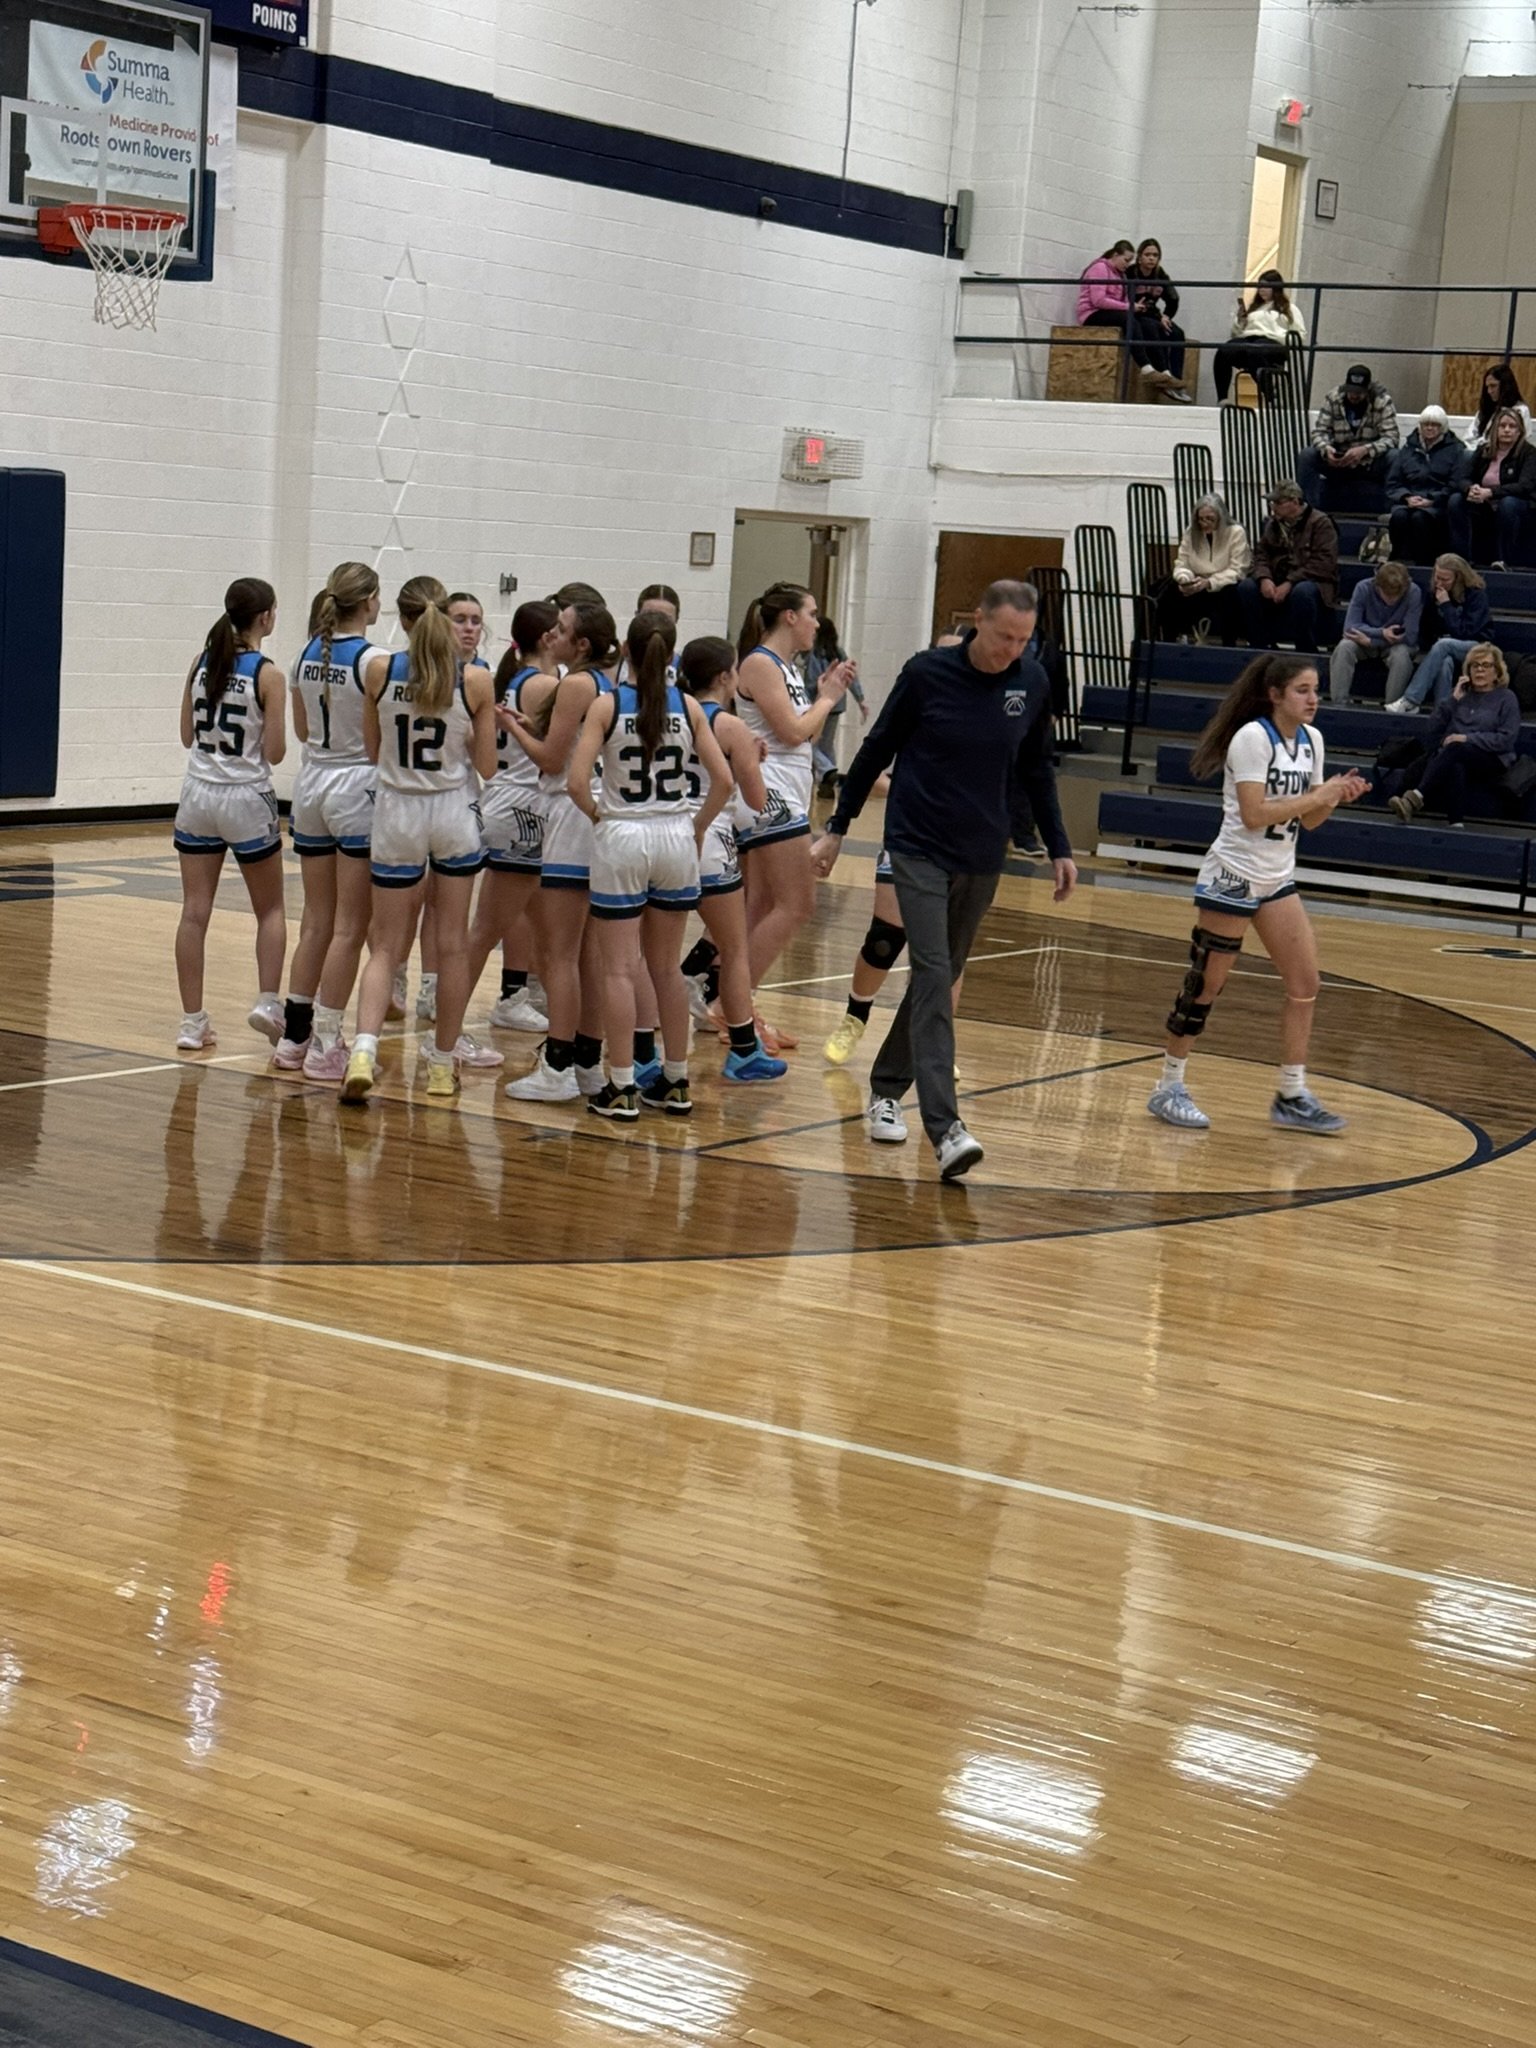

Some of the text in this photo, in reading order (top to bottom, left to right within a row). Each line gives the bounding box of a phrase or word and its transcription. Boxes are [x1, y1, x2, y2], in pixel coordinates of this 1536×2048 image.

[252, 2, 298, 34] POINTS
[107, 50, 171, 82] Summa
[122, 79, 169, 105] Health
[60, 124, 193, 164] Rootsown Rovers
[160, 122, 198, 143] Provid
[207, 132, 220, 147] of
[194, 697, 248, 758] 25
[318, 693, 331, 750] 1
[394, 713, 448, 772] 12
[618, 745, 685, 803] 32
